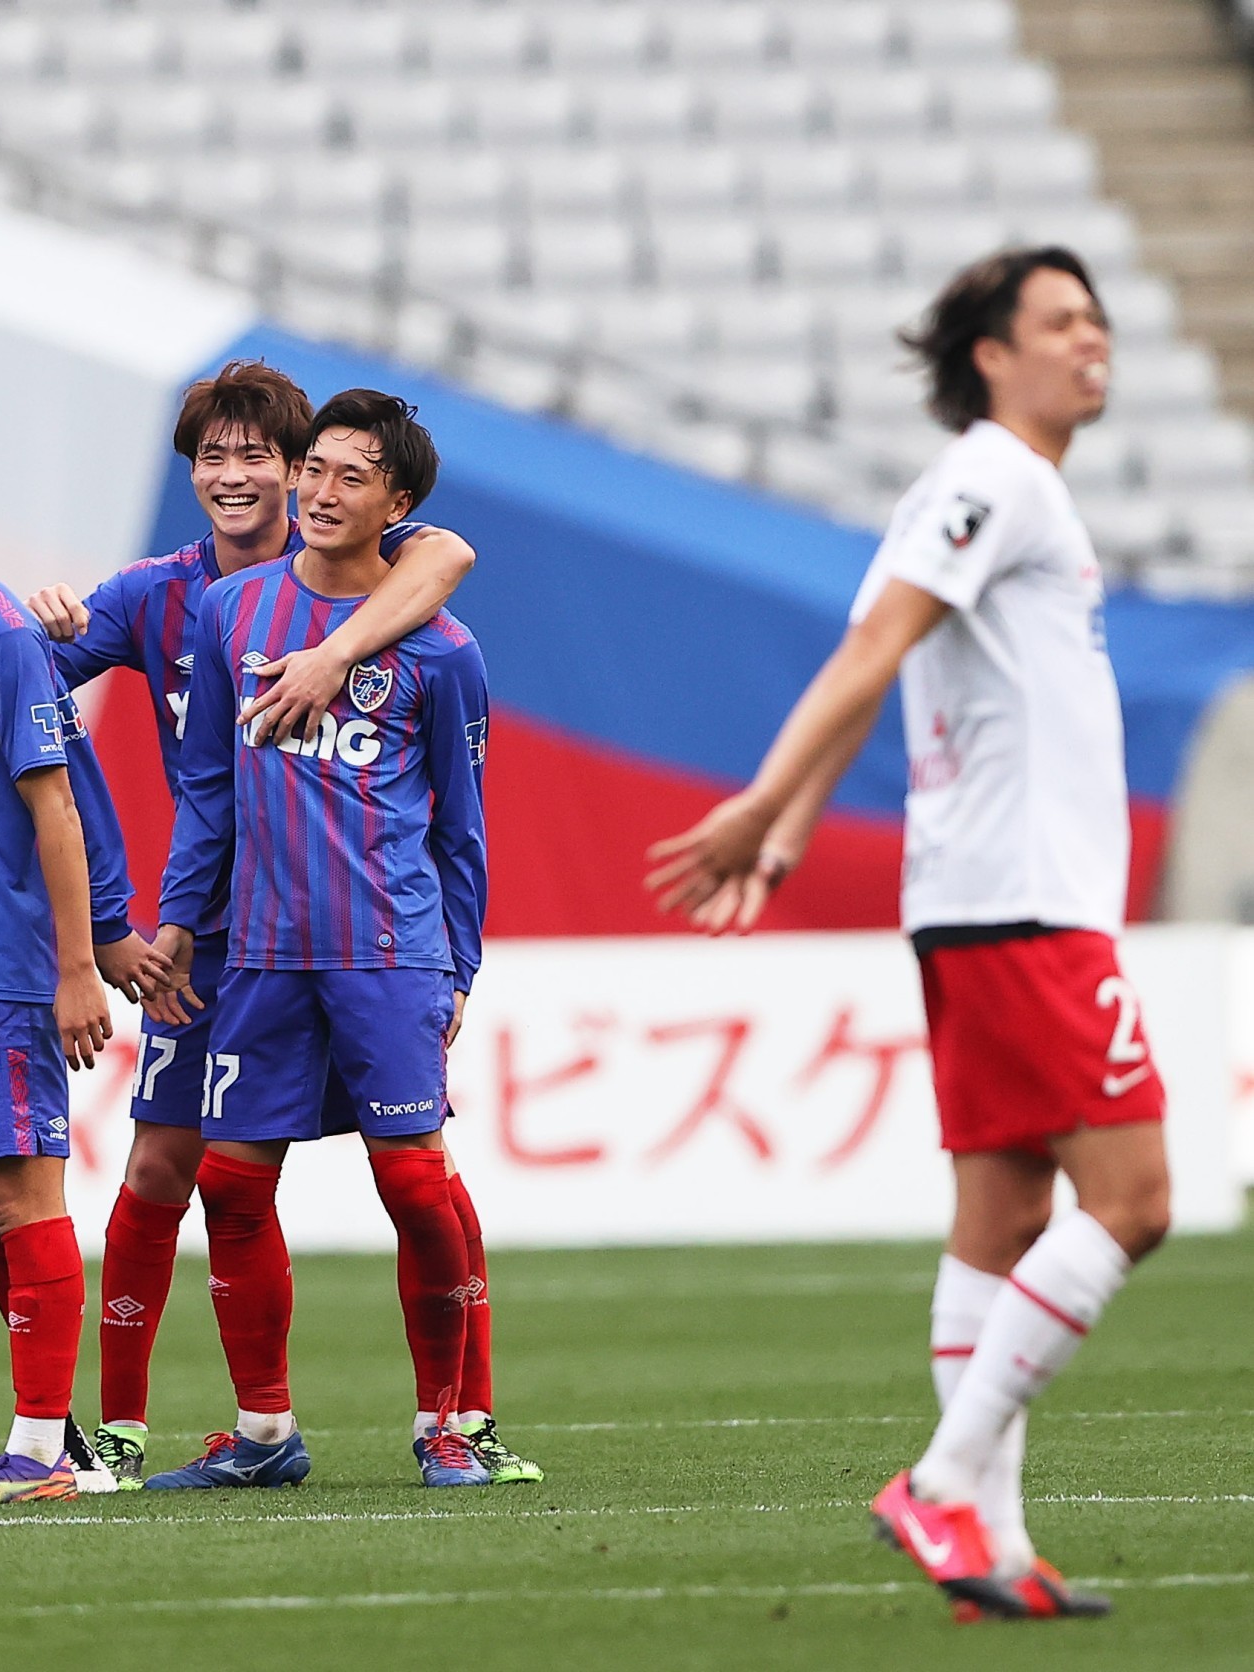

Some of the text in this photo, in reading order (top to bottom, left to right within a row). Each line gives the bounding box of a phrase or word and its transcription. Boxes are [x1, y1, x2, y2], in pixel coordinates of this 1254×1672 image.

[382, 1099, 434, 1116] TOKYO GAS
[103, 1317, 144, 1327] umbro
